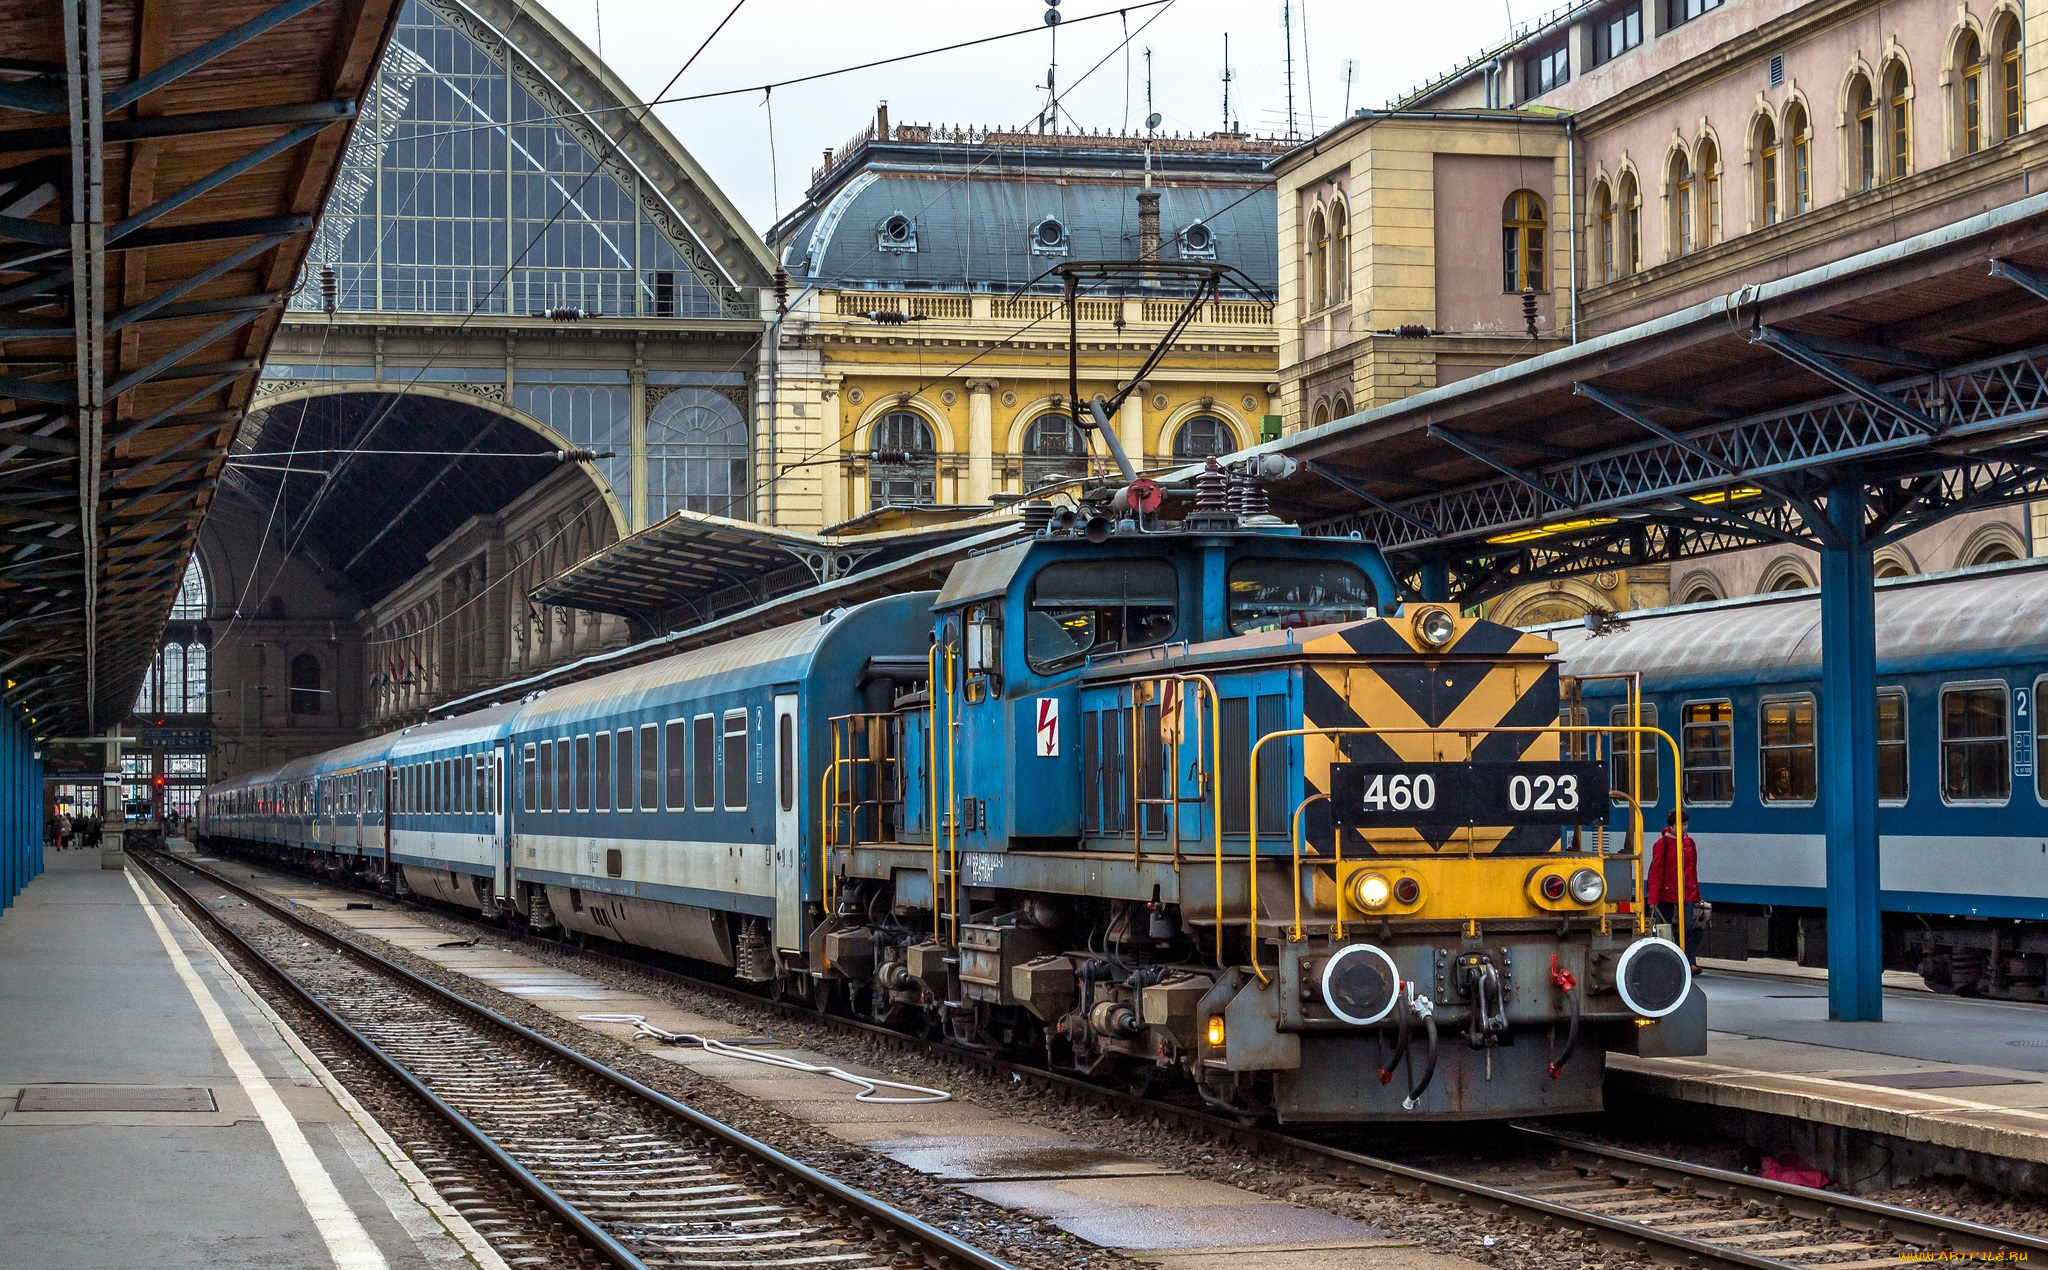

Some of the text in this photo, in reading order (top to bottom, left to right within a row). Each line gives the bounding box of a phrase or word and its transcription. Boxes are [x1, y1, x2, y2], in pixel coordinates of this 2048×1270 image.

[2017, 691, 2027, 716] 2
[1363, 774, 1580, 812] 460 023
[972, 866, 994, 882] H-START
